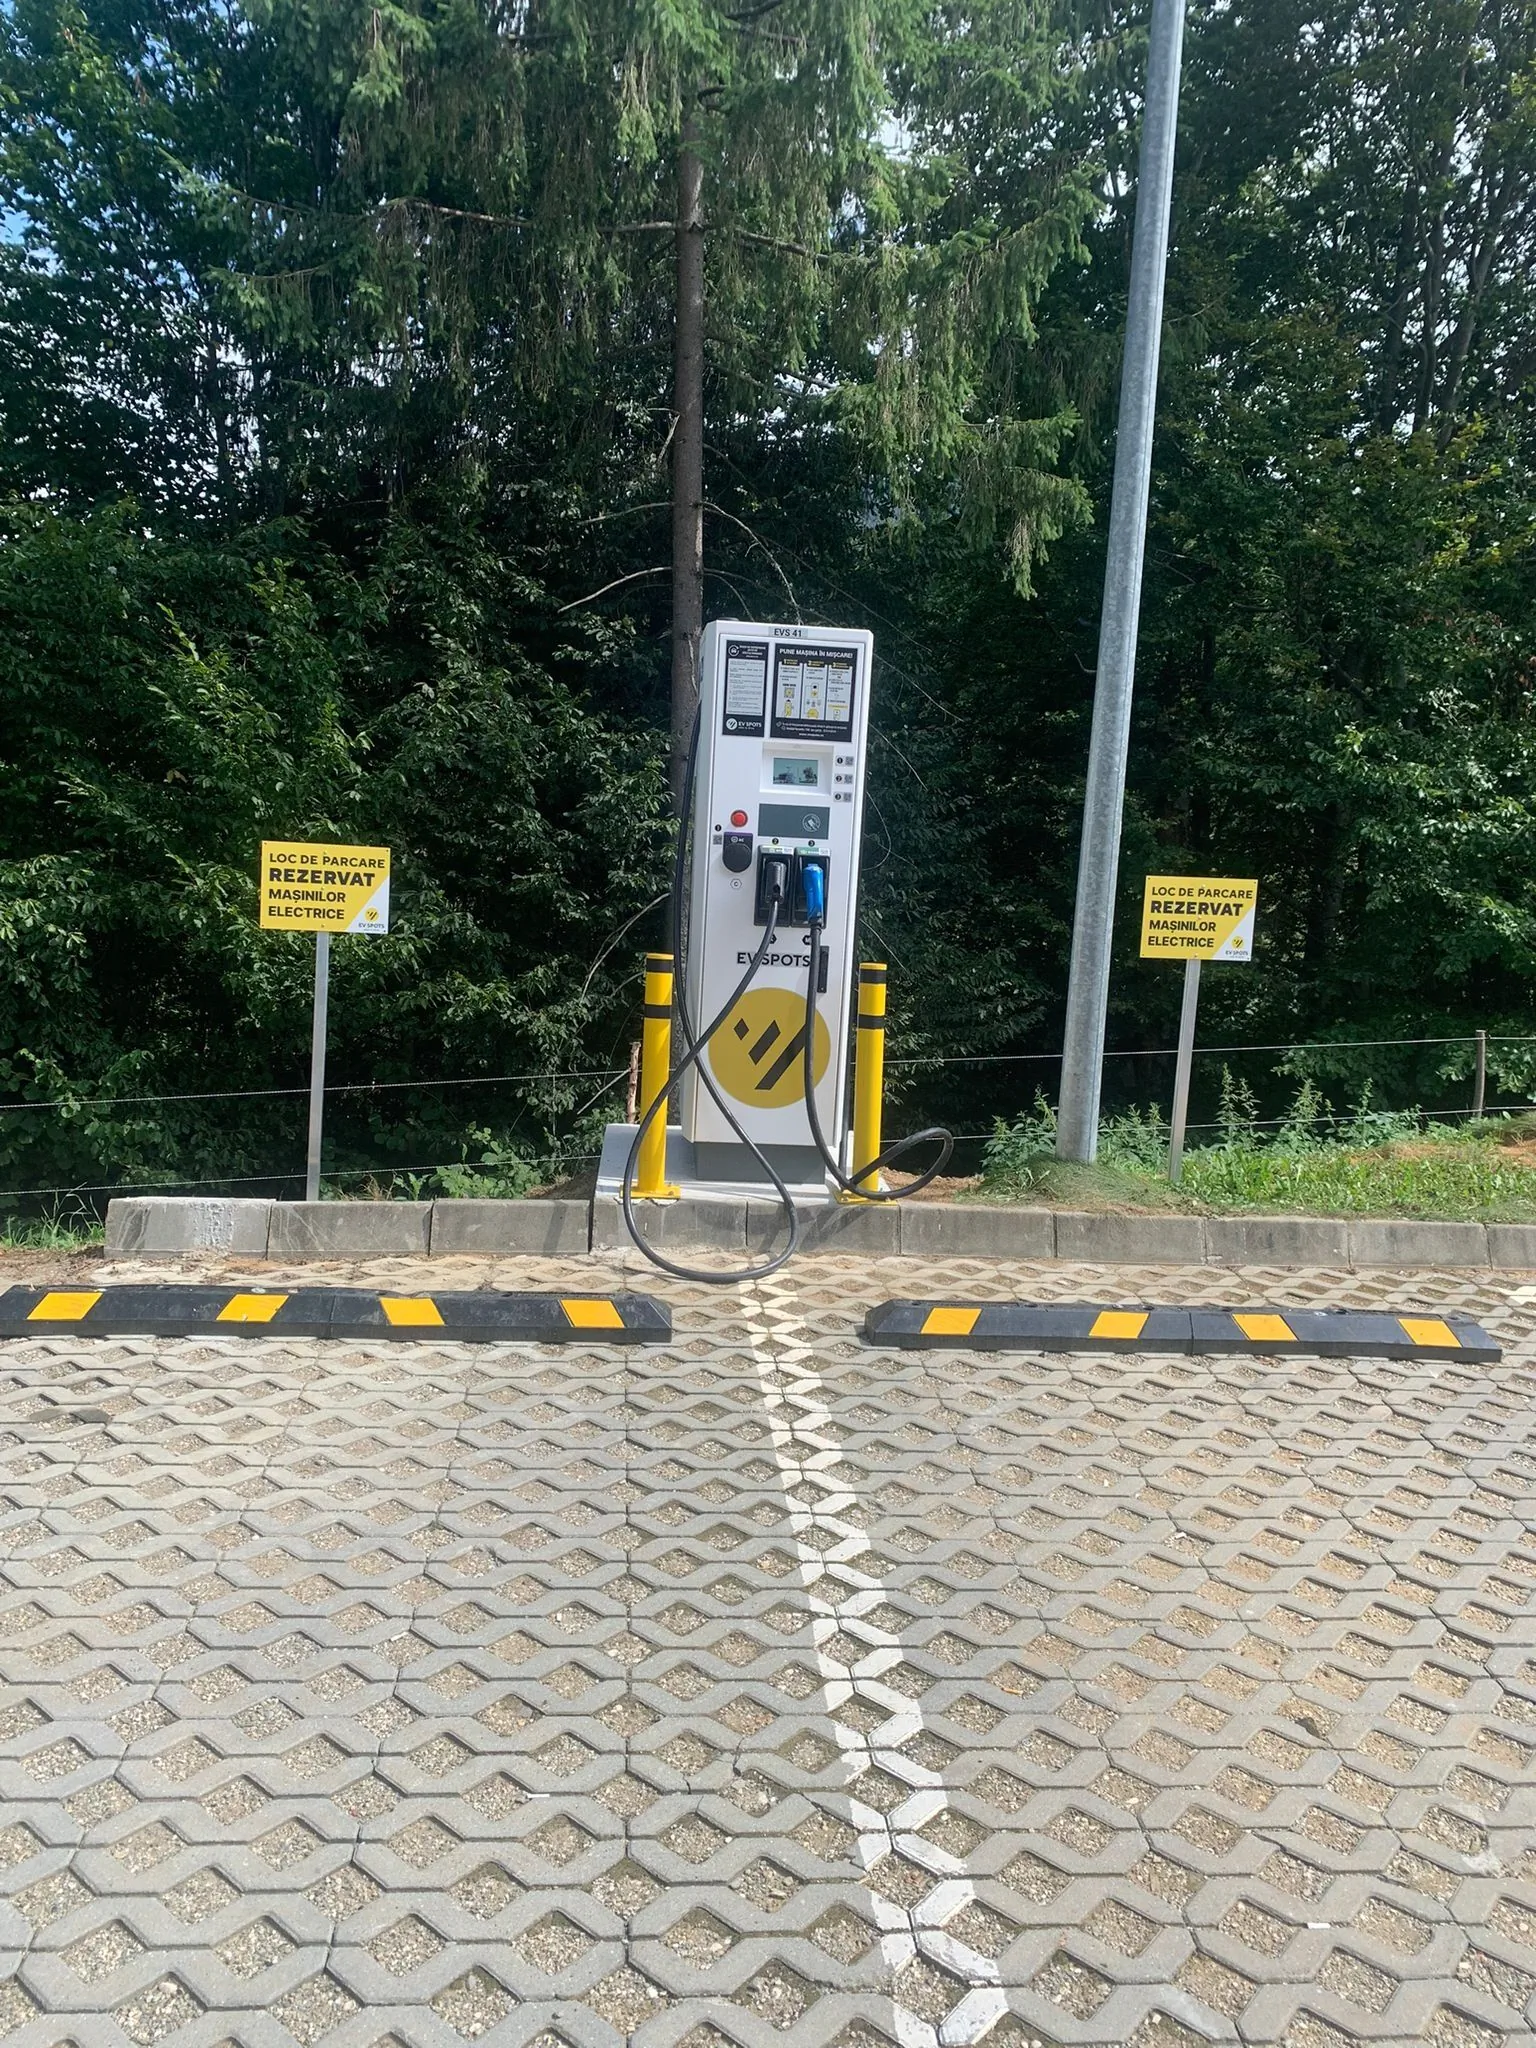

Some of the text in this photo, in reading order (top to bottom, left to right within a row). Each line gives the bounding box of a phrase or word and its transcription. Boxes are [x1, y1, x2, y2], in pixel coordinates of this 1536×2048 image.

[774, 629, 802, 638] EVS 41
[779, 648, 795, 656] PUNE
[269, 852, 385, 869] LOC DE PARCARE
[269, 867, 375, 887] REZERVAT
[268, 888, 346, 903] MAȘINILOR
[1151, 886, 1253, 899] LOC DE PARCARE
[268, 905, 345, 919] ELECTRICE
[1150, 900, 1243, 916] REZERVAT
[1149, 919, 1216, 933] MAȘINILOR
[1147, 935, 1214, 948] ELECTRICE
